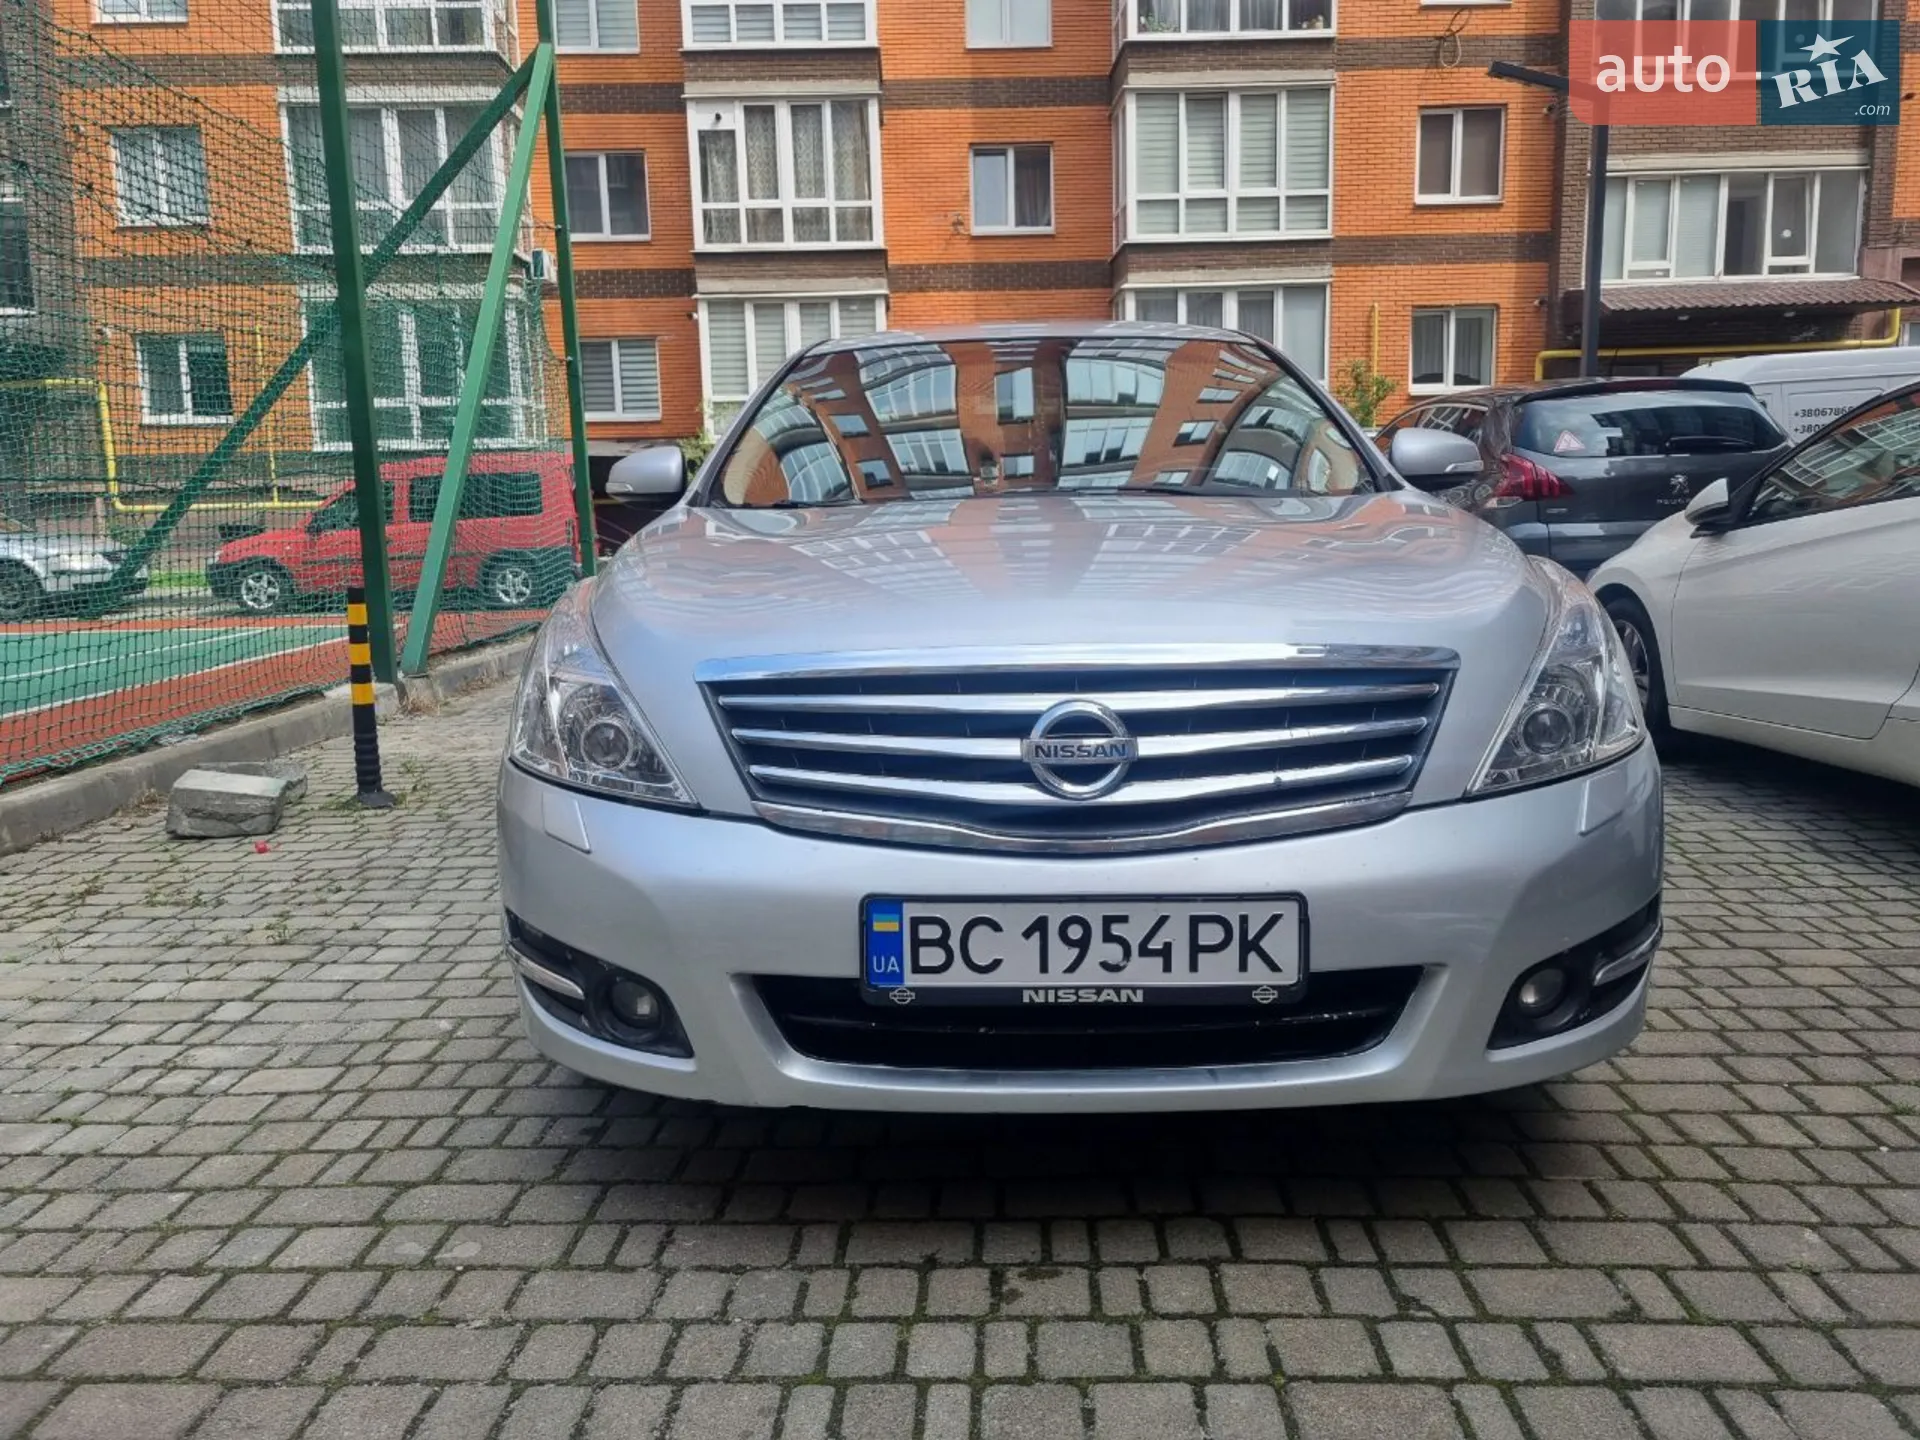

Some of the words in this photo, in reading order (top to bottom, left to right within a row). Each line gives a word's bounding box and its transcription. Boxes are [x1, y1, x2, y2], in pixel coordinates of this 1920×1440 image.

[1034, 743, 1126, 758] NISSAN
[909, 914, 1005, 975] BC
[1021, 914, 1173, 974] 1954
[1188, 913, 1284, 974] PK
[873, 955, 900, 973] UA
[1022, 988, 1144, 1003] NISSAN
